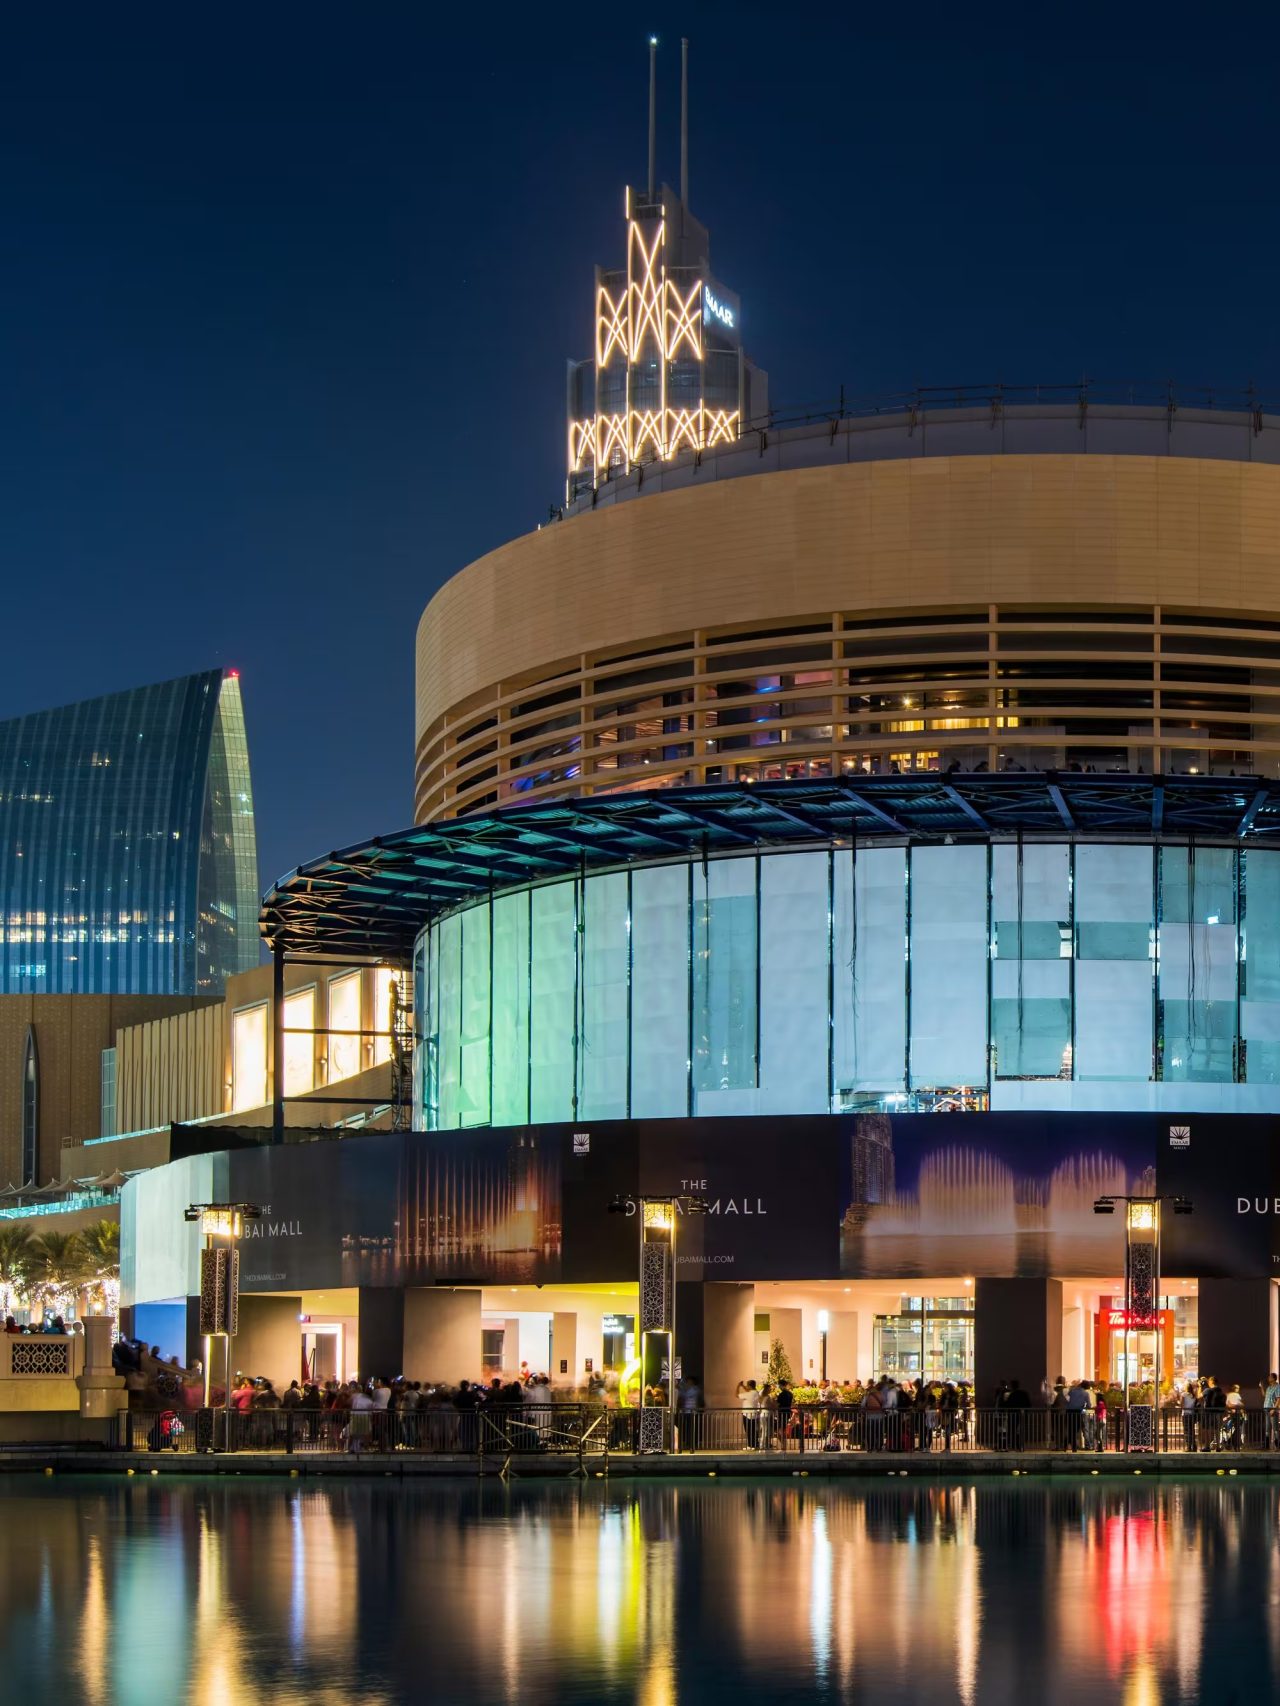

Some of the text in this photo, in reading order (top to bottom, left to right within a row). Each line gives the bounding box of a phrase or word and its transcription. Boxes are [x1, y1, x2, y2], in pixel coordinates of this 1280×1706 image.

[681, 1179, 708, 1190] THE
[262, 1205, 272, 1215] HE
[708, 1198, 767, 1215] MALL
[237, 1220, 303, 1239] UBAI MALL
